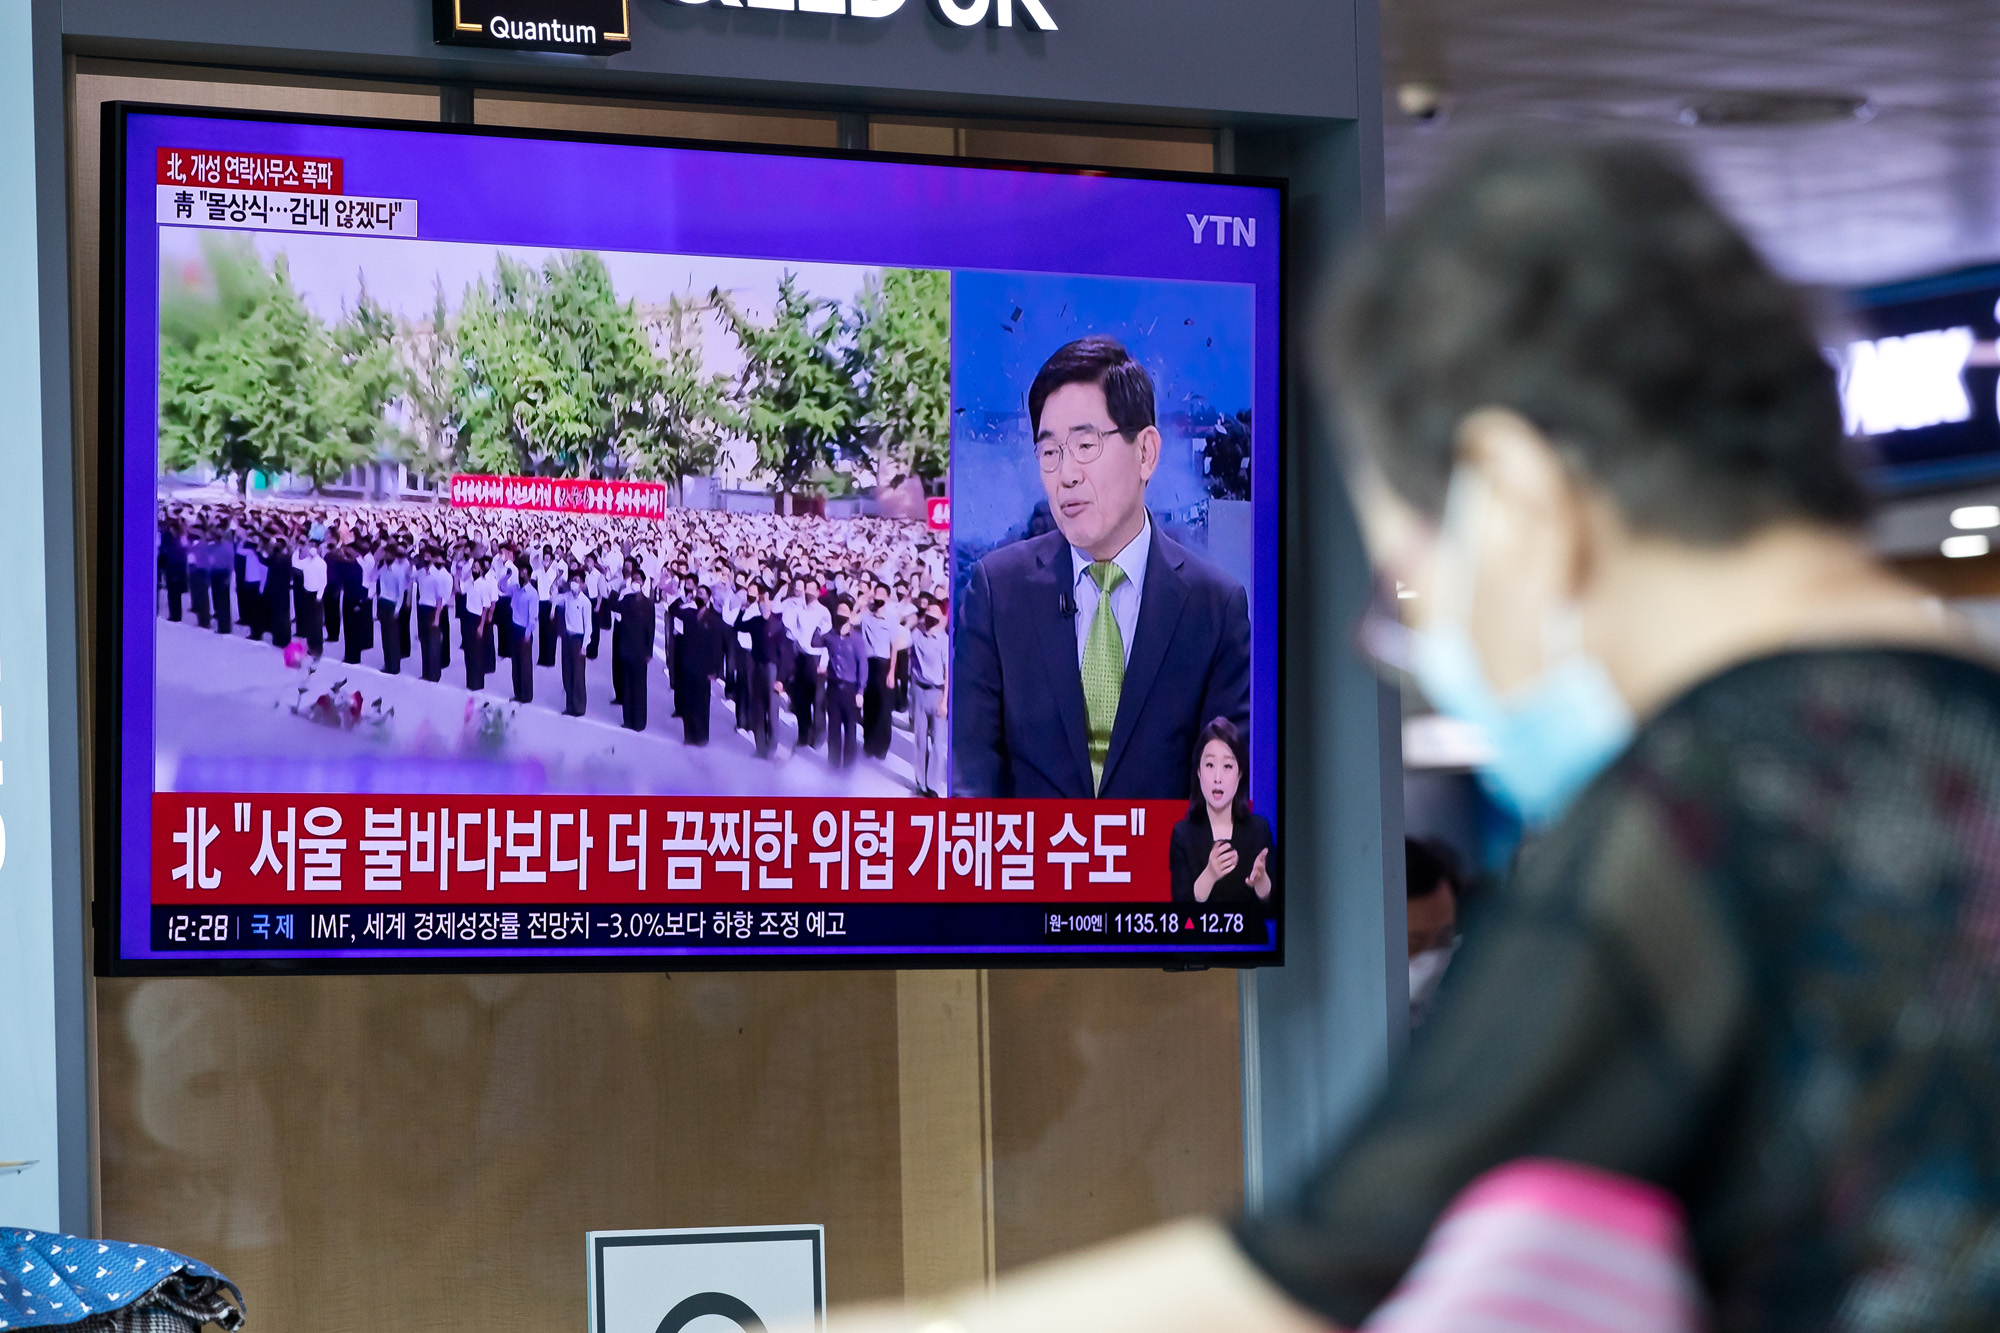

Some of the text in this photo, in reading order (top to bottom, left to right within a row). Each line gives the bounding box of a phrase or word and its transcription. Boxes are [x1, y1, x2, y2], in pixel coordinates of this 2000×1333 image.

[490, 15, 597, 44] Quantum
[190, 154, 220, 183] 개성
[224, 156, 299, 187] 연락사무소
[302, 160, 333, 190] 폭파
[334, 200, 402, 230] 않겠다"
[1186, 213, 1256, 248] YTN
[171, 801, 1146, 892] 北 "서울 불바다보다 더 끔찍한 위협 가해질 수도"
[168, 915, 229, 942] 12:28
[310, 913, 357, 943] IMF,
[362, 911, 407, 941] 세계
[413, 911, 521, 941] 경제성장률
[527, 911, 591, 940] 전망치
[712, 910, 754, 939] 하향
[758, 910, 800, 939] 조정
[805, 910, 847, 938] 예고
[1114, 913, 1180, 934] 1135.18
[1199, 912, 1245, 934] 12.78
